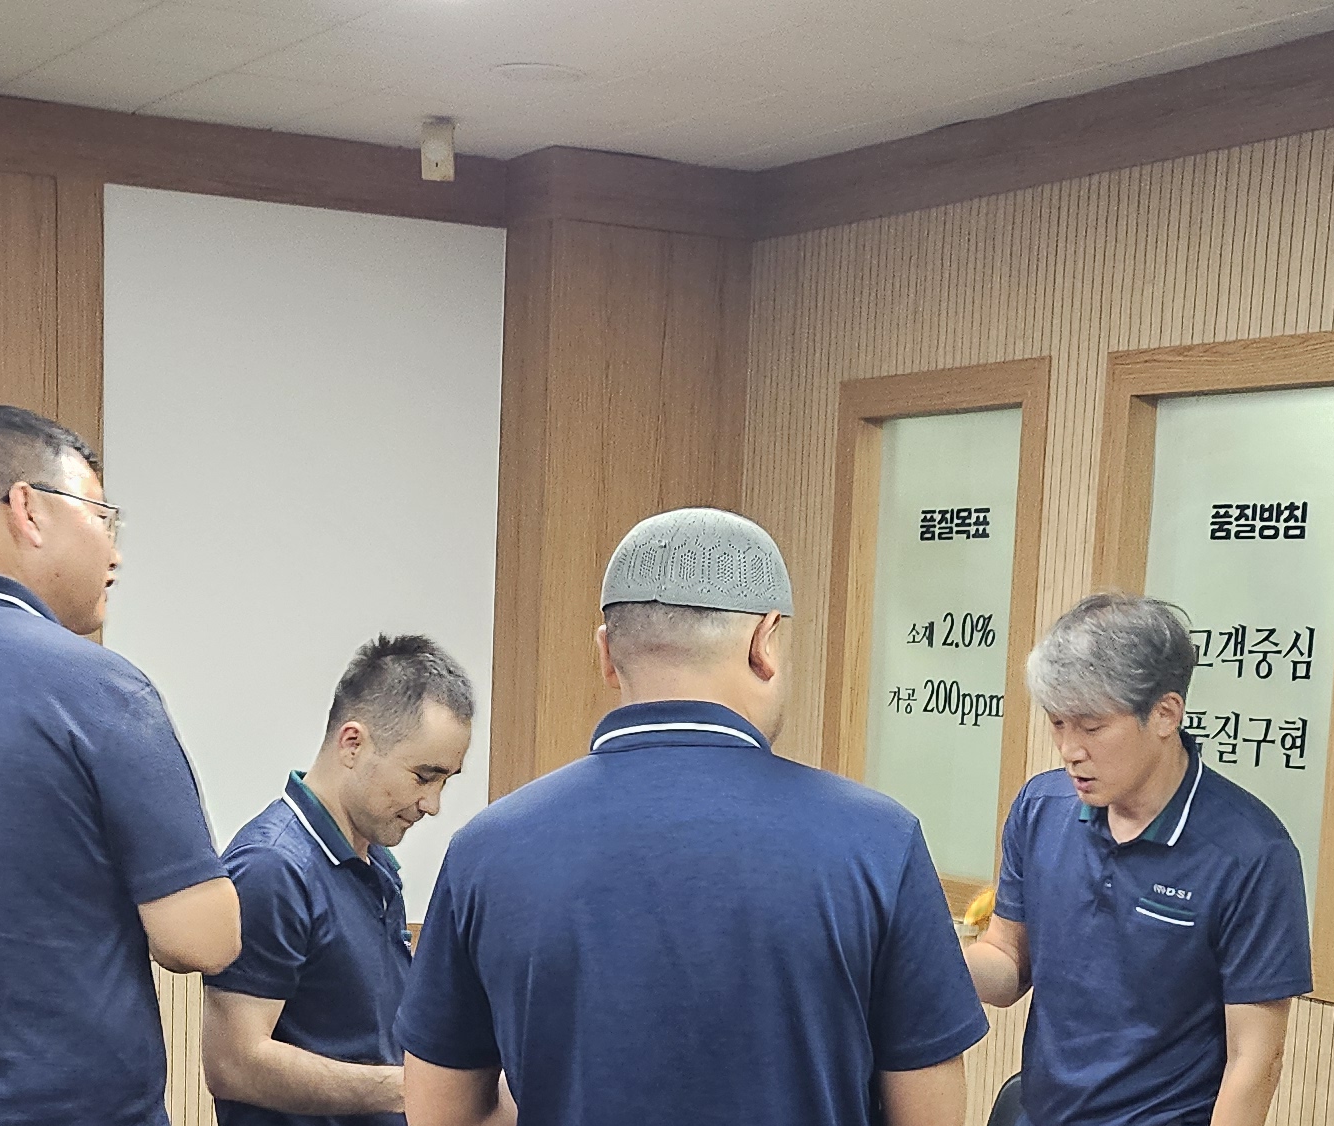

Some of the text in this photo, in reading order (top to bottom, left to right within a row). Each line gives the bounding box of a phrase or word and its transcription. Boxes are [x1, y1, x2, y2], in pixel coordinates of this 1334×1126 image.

[919, 507, 991, 542] 품질목표
[1209, 501, 1308, 541] 품질방침
[906, 612, 996, 649] 소재 2.0%
[1189, 623, 1316, 682] 고객중심
[888, 679, 1005, 727] 가공 200ppm
[1184, 711, 1308, 770] 품질구현
